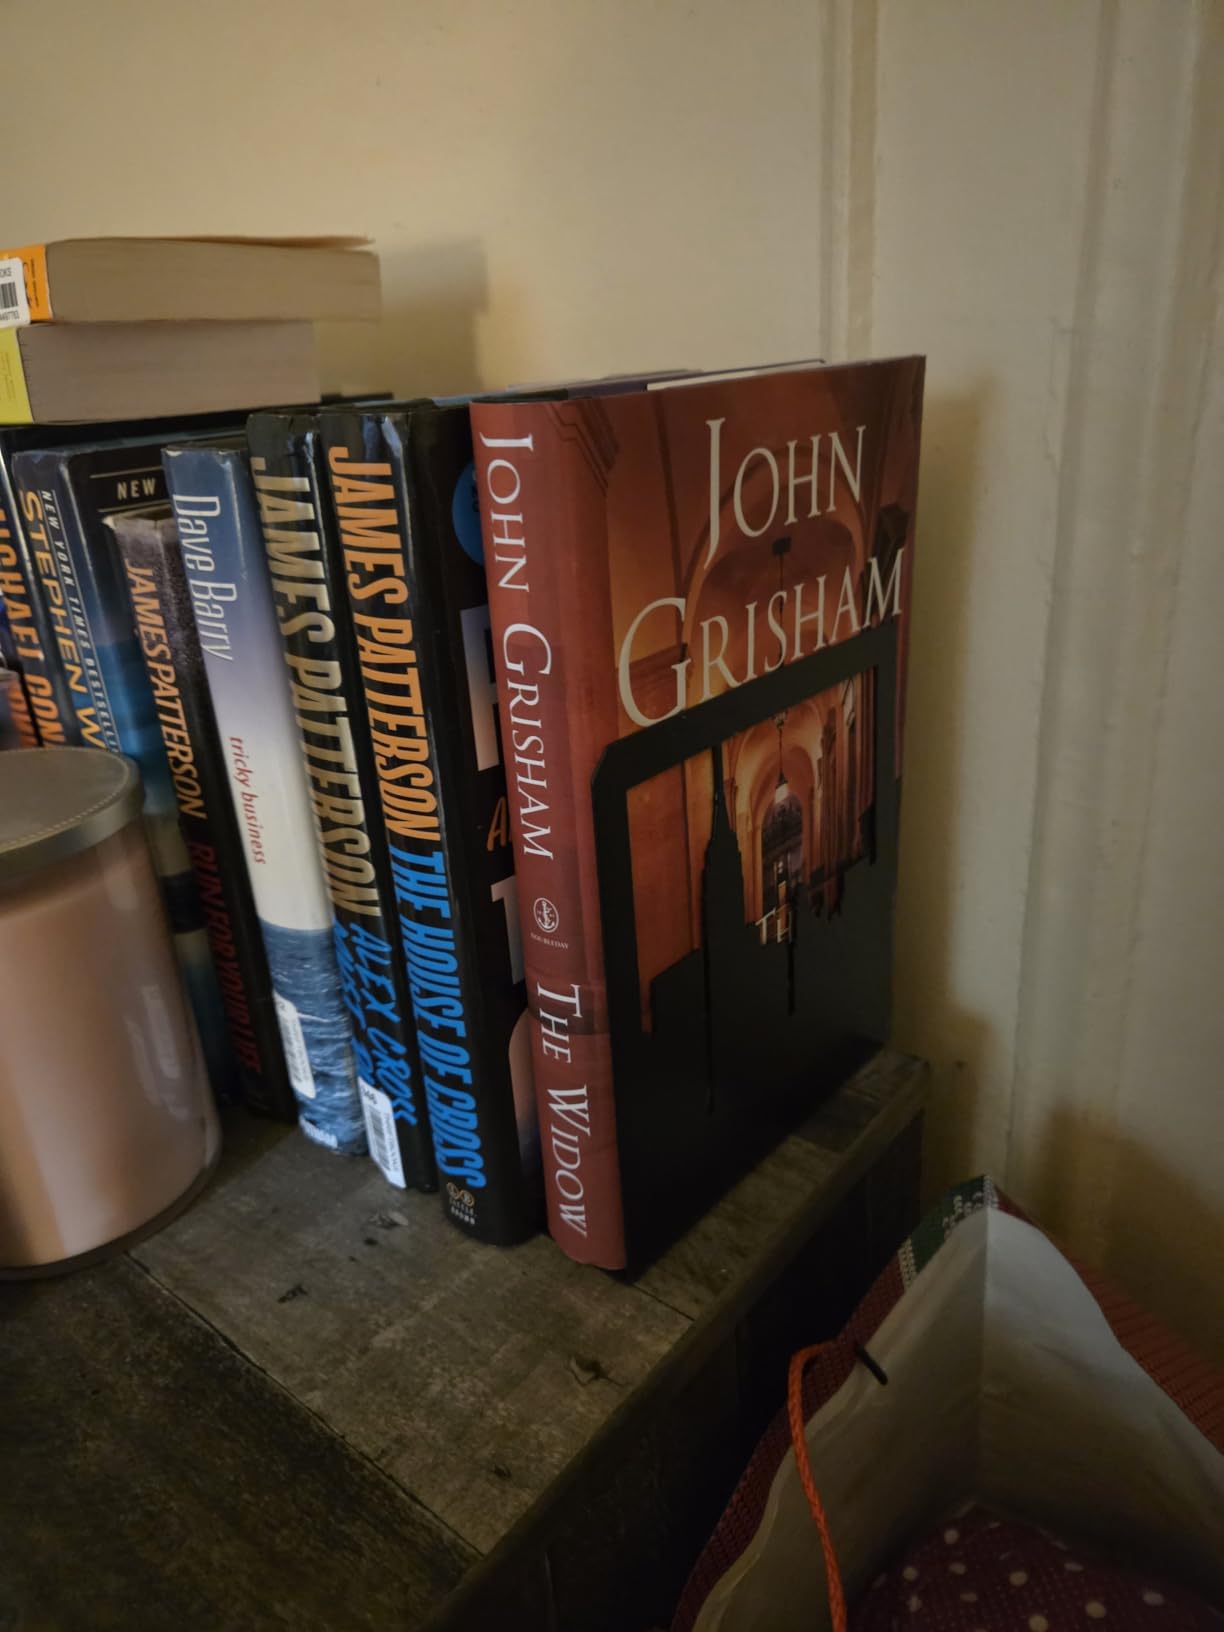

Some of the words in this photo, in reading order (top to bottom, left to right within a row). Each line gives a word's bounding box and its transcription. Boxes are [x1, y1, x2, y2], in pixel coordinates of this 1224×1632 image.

[41, 489, 61, 531] NEW
[54, 540, 76, 587] YORK
[116, 478, 157, 500] NEW
[172, 493, 222, 573] Dave
[328, 444, 409, 606] JAMES
[479, 432, 535, 593] JOHN
[703, 416, 867, 570] JOHN
[22, 489, 88, 693] STEPHEN
[249, 454, 337, 646] JAMES
[123, 557, 173, 663] JAMES
[189, 579, 238, 662] Barry
[617, 547, 906, 727] GRISHAM
[147, 659, 208, 821] PATTERSON
[229, 736, 254, 788] tricky
[285, 648, 383, 917] PATTERSON
[352, 611, 442, 843] PATTERSON
[501, 622, 554, 861] GRISHAM
[240, 791, 267, 866] business
[388, 843, 452, 922] THE
[349, 922, 401, 1023] ALEX
[399, 913, 467, 1041] HOUSE
[536, 983, 583, 1065] THE
[366, 1026, 417, 1126] CROSS
[416, 1030, 473, 1085] OF
[423, 1076, 487, 1189] CROSS
[545, 1083, 592, 1239] WIDOW
